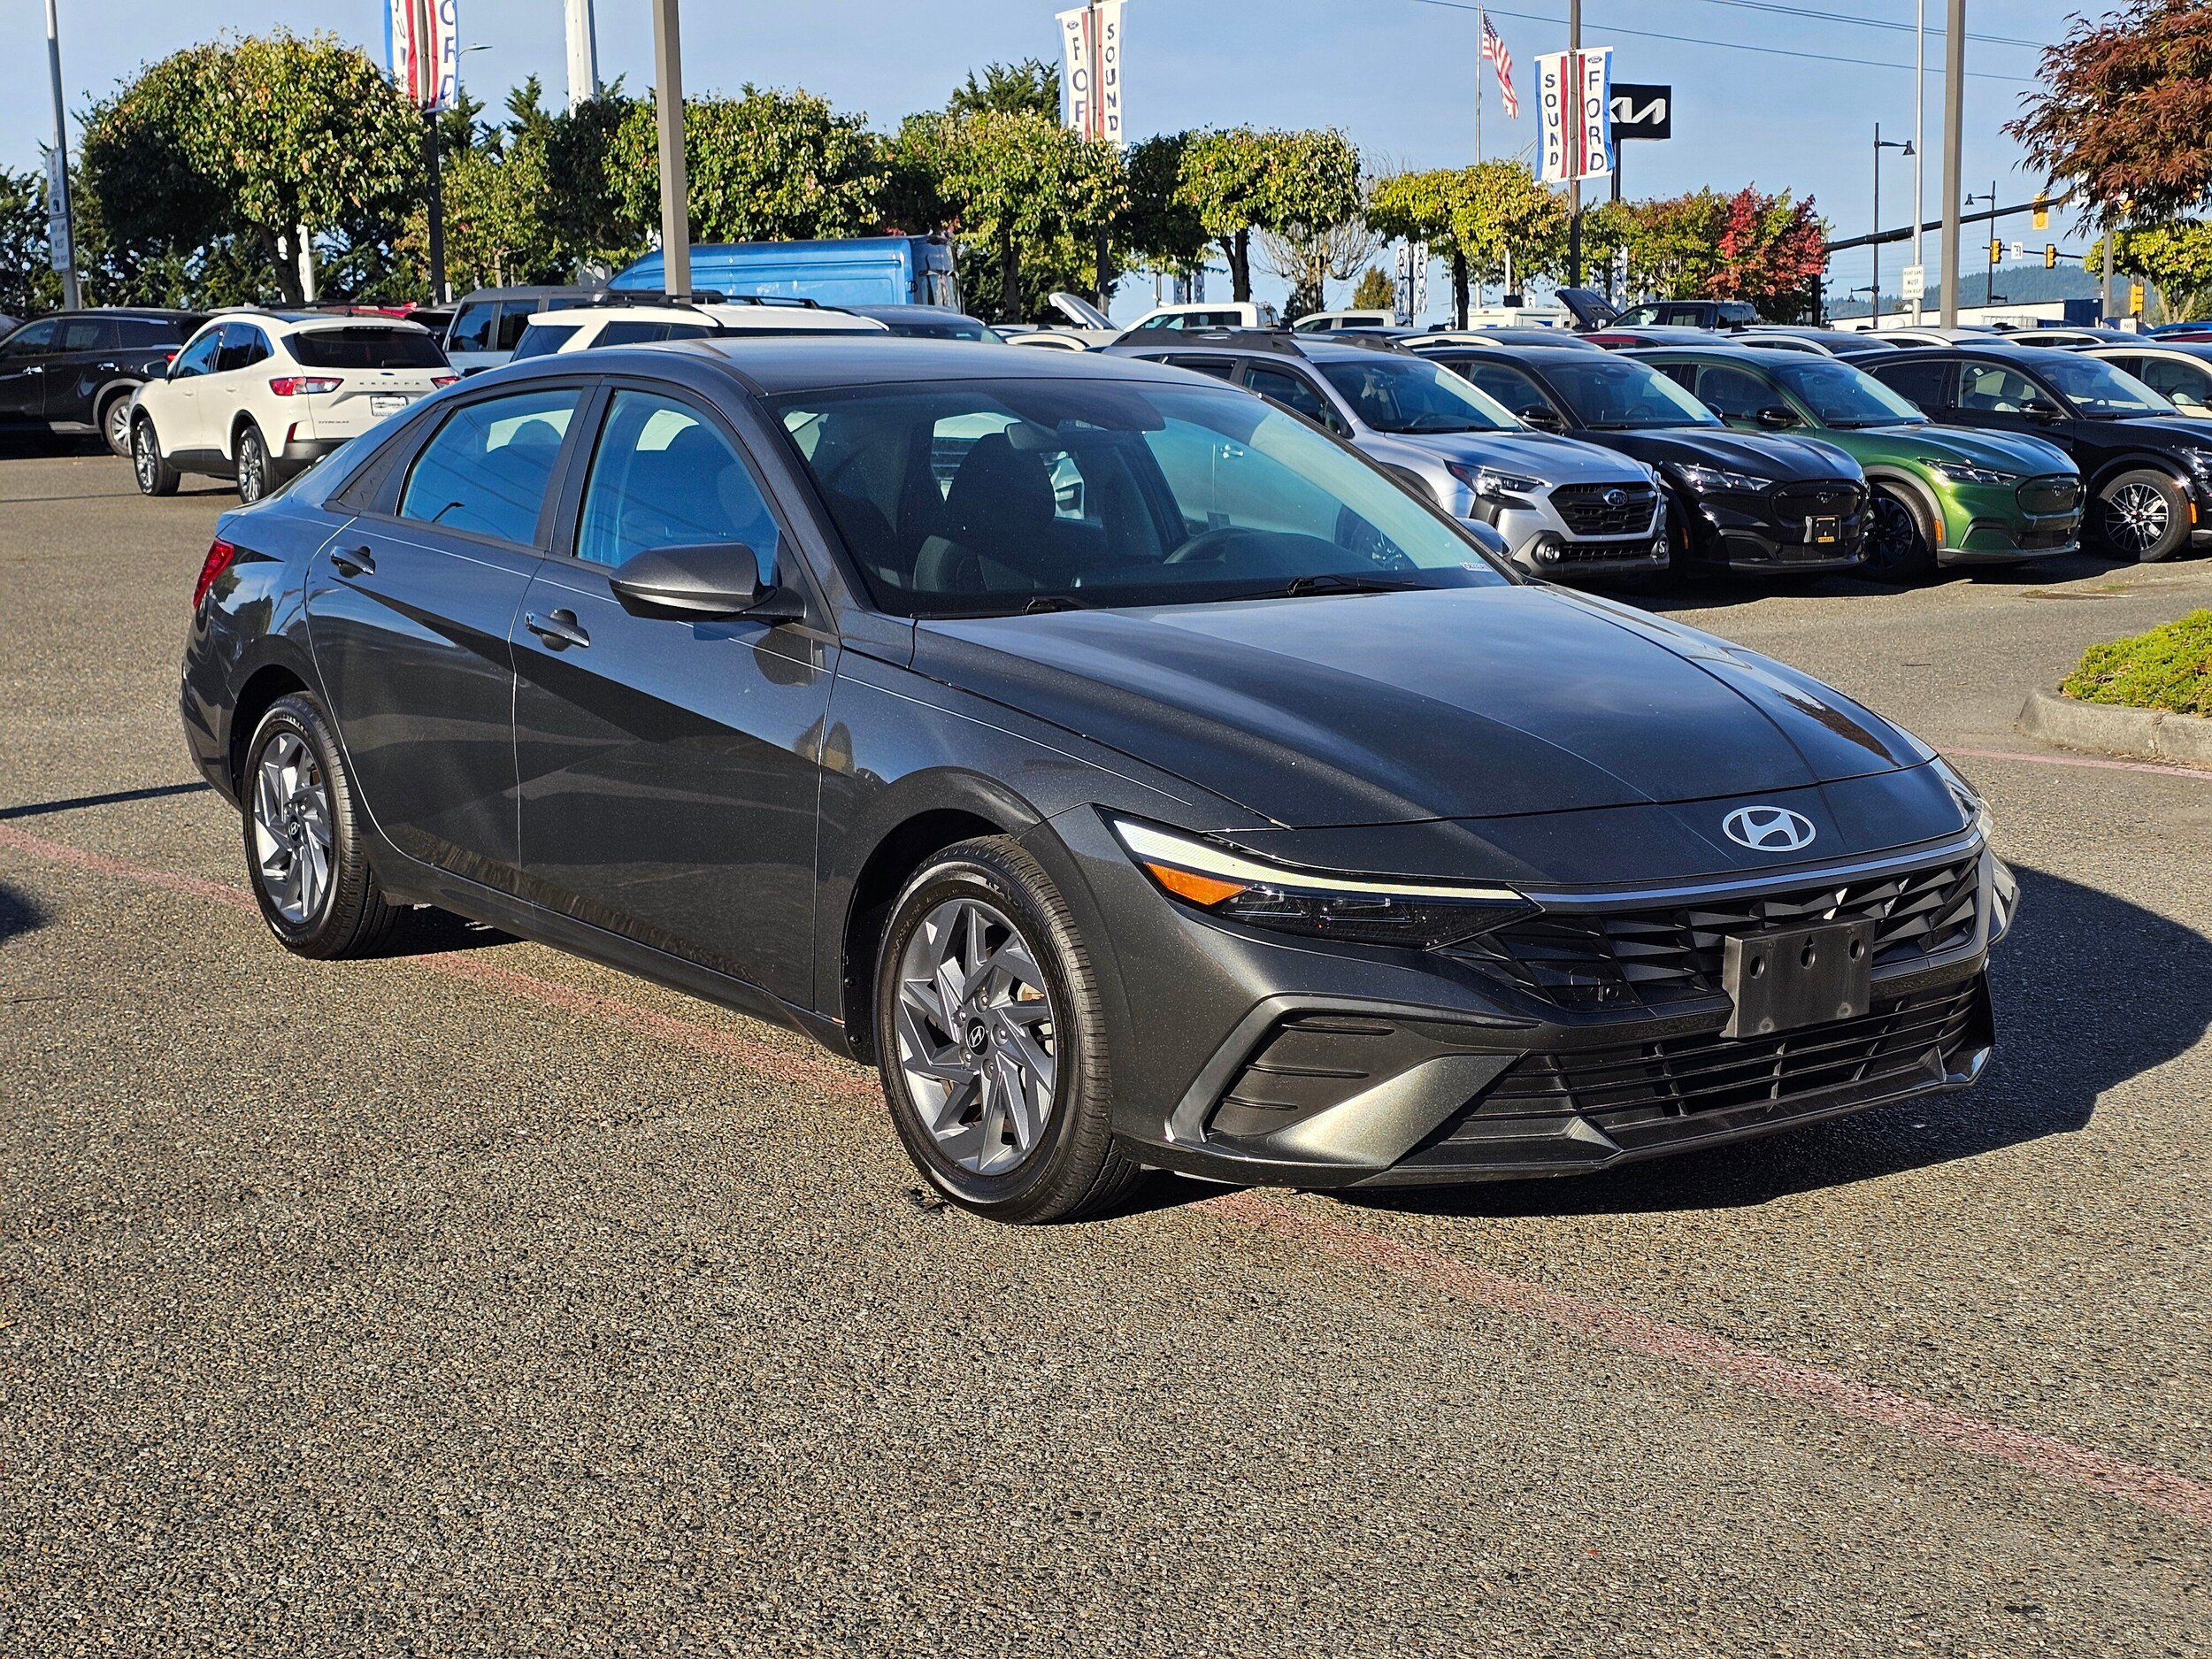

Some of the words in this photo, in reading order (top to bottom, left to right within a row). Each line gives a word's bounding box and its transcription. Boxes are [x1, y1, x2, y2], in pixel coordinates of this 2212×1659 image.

[1105, 23, 1118, 131] SOUND
[1545, 73, 1559, 166] SOUND
[1586, 70, 1604, 171] FORD
